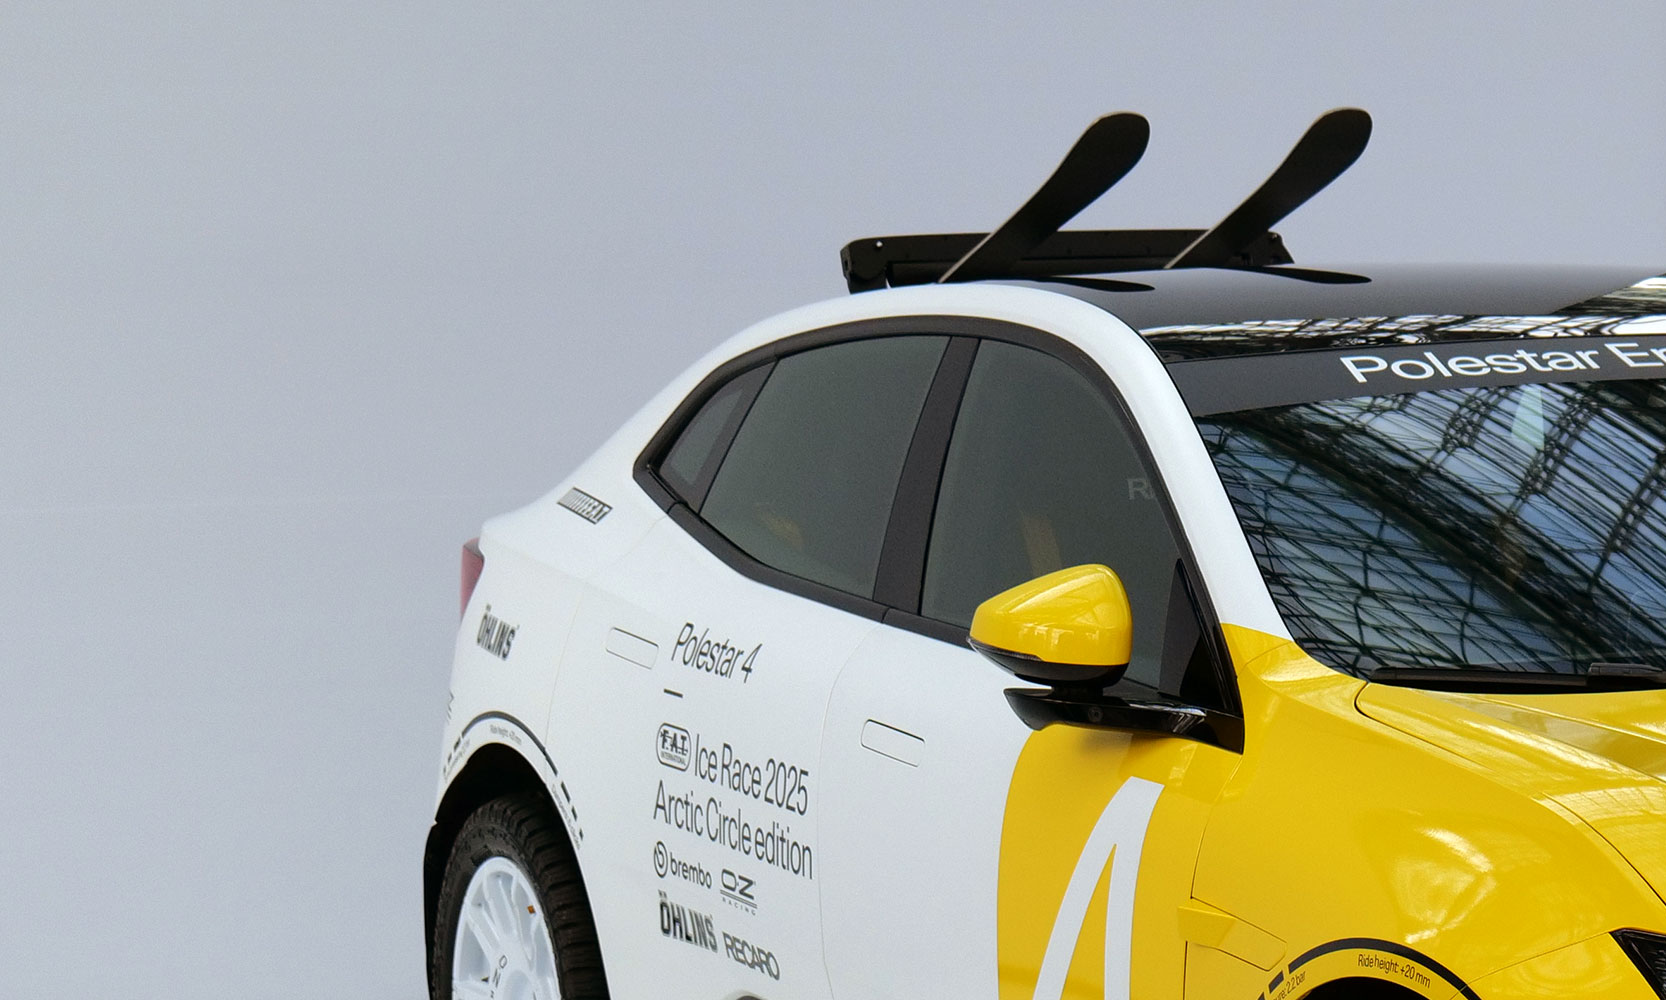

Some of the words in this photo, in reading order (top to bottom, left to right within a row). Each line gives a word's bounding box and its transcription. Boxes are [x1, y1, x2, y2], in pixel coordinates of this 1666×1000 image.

[1340, 349, 1600, 383] Polestar
[476, 603, 519, 662] ÖHLINS
[671, 621, 744, 679] Polestar
[741, 643, 763, 683] 4
[695, 733, 718, 783] Ice
[720, 743, 762, 799] Race
[764, 758, 808, 816] 2025
[653, 779, 703, 836] Arctic
[706, 797, 752, 855] Circle
[755, 820, 813, 880] edition
[670, 852, 712, 889] brembo
[658, 889, 718, 953] ÖHLINS
[722, 931, 780, 981] RECARO
[1357, 954, 1374, 968] Ride
[1374, 954, 1399, 974] height:
[1400, 963, 1416, 980] +20
[1415, 972, 1431, 988] mm
